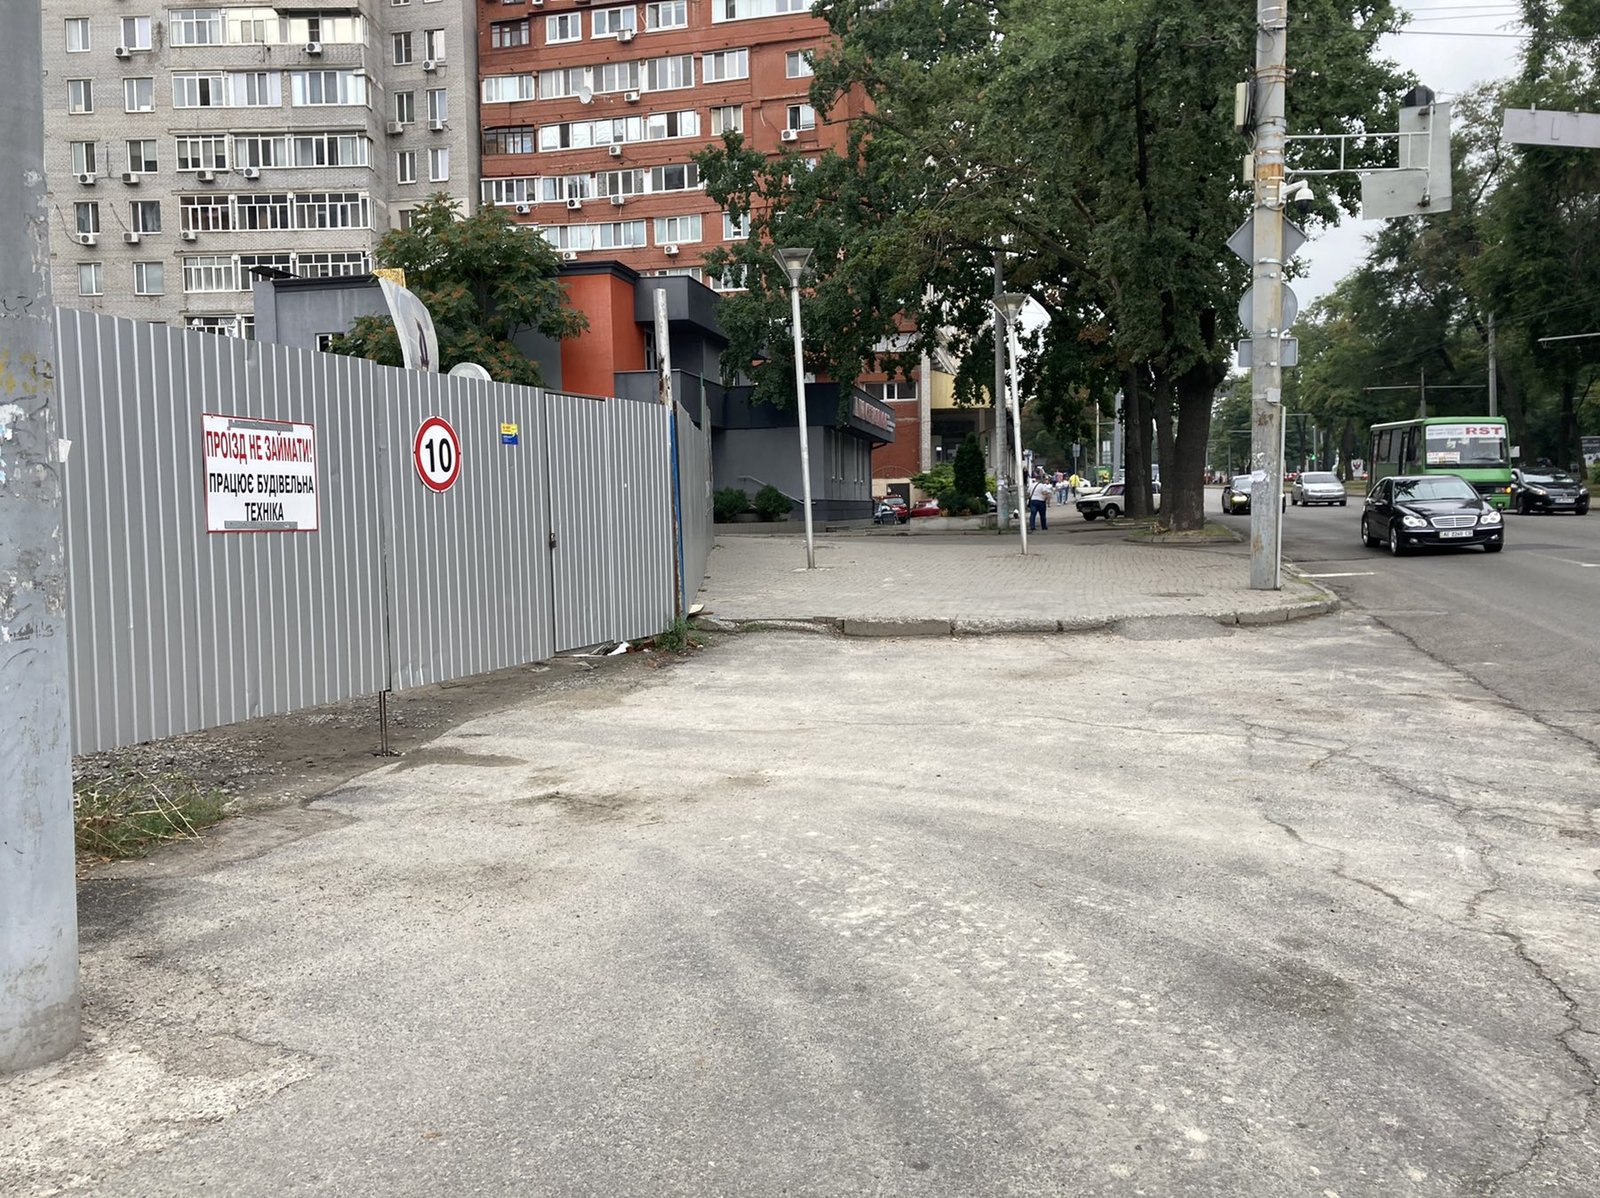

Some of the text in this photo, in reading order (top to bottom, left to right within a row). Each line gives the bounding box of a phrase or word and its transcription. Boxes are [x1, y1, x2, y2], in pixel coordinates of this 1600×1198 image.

[1465, 426, 1502, 435] RST
[206, 428, 313, 464] ПРОЇЗД НЕ ЗАЙМАТИ!
[425, 438, 452, 473] 10
[209, 472, 314, 497] ПРАЦЮЄ БУДІВЕЛЬНА
[245, 502, 284, 521] ТЕХНІКА
